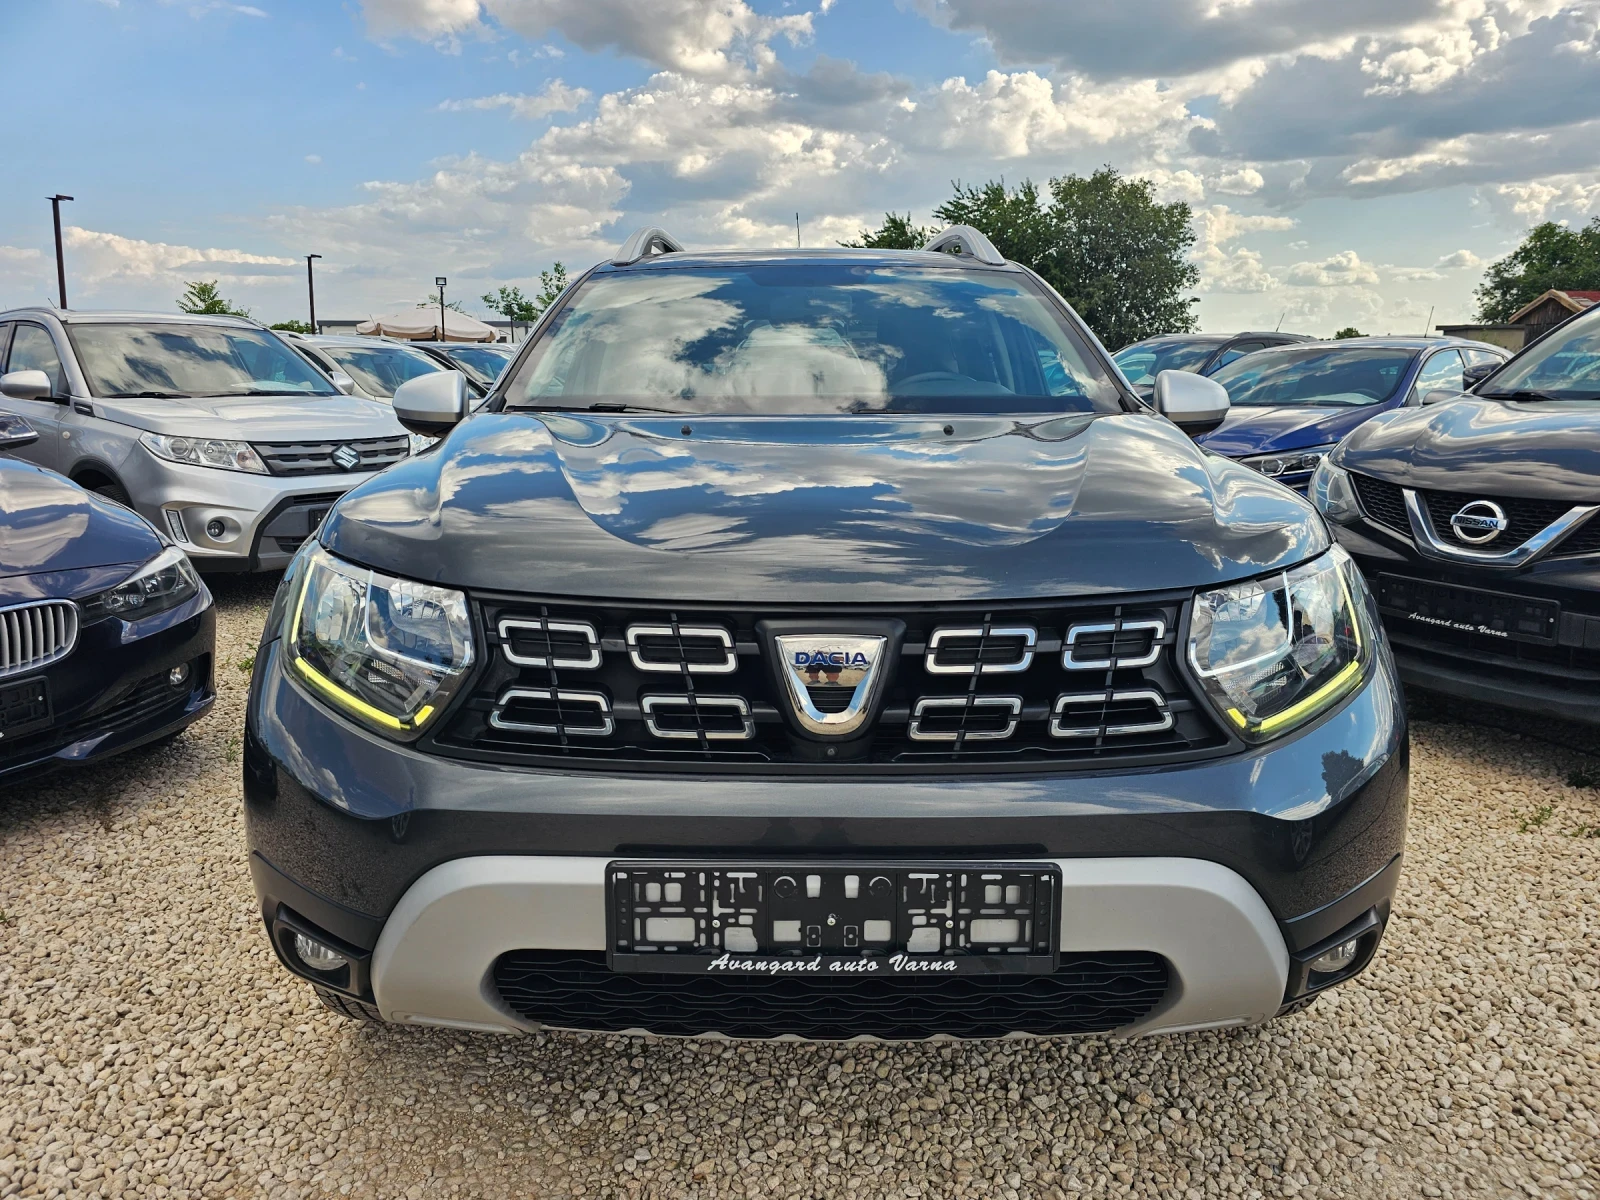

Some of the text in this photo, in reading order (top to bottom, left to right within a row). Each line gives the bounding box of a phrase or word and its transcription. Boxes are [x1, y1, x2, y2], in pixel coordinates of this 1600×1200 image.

[1453, 515, 1499, 528] NISSAN
[1408, 612, 1508, 637] Avangard auto Varna
[794, 651, 868, 665] DACIA
[708, 954, 958, 975] Avangard auto Varna
